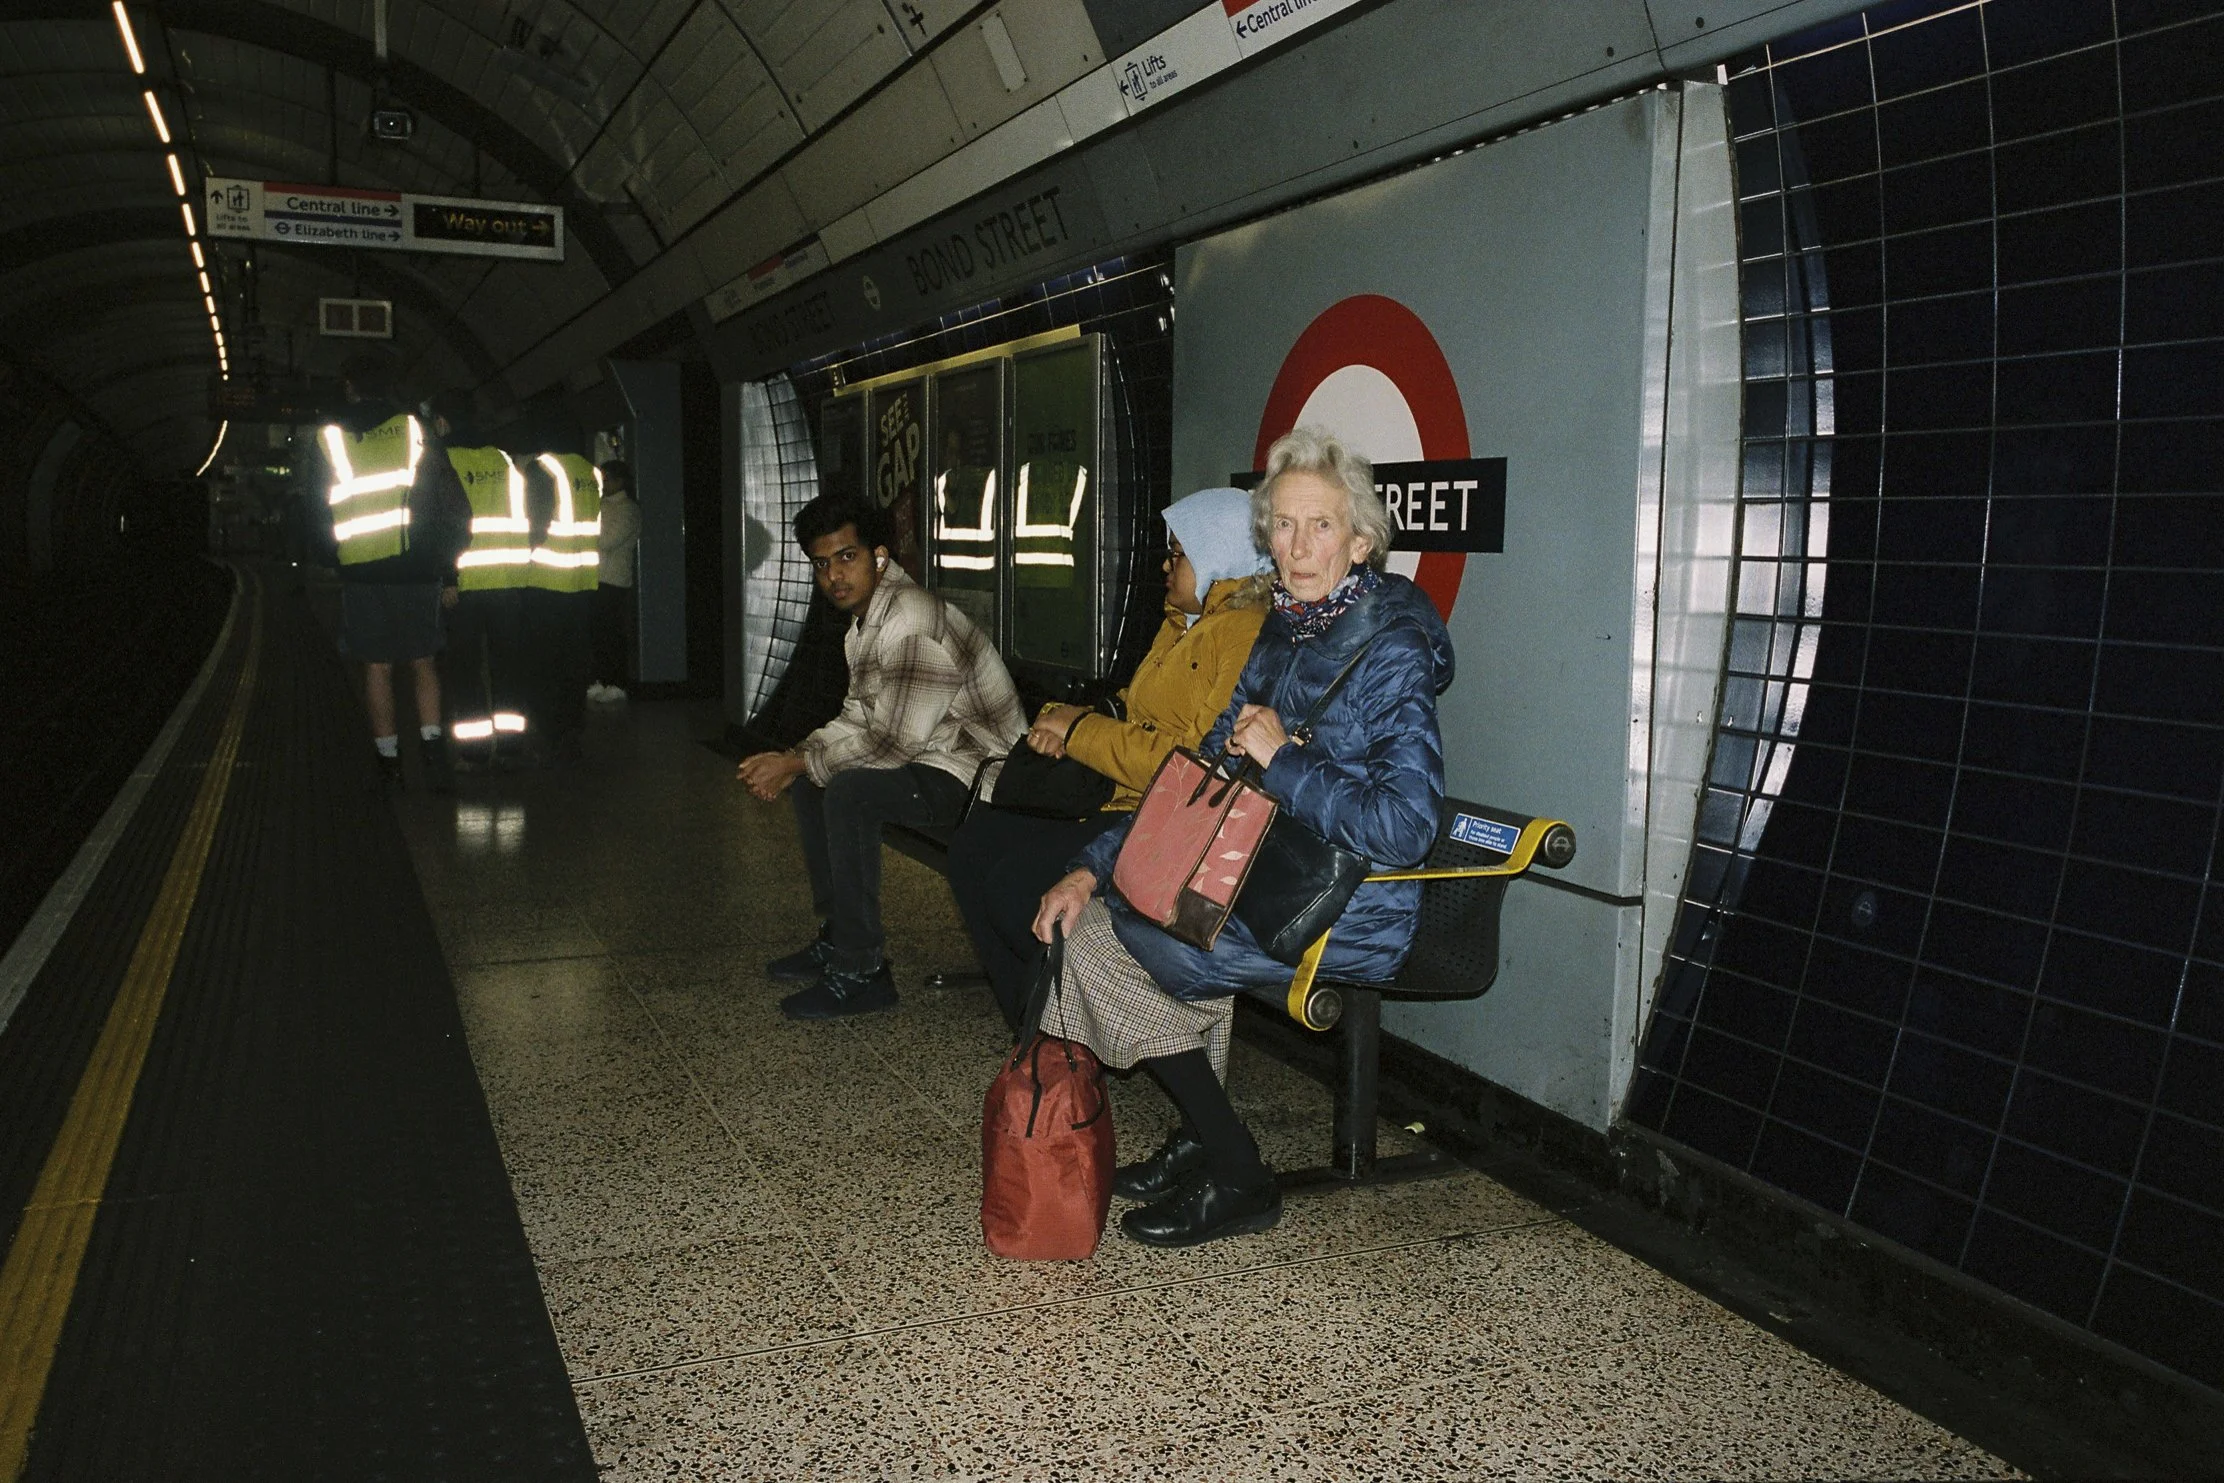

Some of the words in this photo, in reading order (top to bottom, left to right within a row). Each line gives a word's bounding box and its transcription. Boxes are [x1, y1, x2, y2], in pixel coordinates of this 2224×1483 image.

[1246, 0, 1294, 33] Central
[1141, 55, 1167, 76] Lifts
[286, 196, 345, 214] Central
[351, 201, 381, 217] line
[295, 223, 359, 240] Elizabeth
[362, 228, 386, 241] line
[444, 212, 487, 235] Way
[492, 216, 527, 235] out
[906, 234, 974, 296] BOND
[974, 186, 1069, 269] STREET
[880, 396, 904, 448] SEE
[877, 422, 920, 509] GAP
[1375, 480, 1478, 531] REET
[1472, 820, 1491, 832] Priority
[1490, 825, 1502, 835] seat
